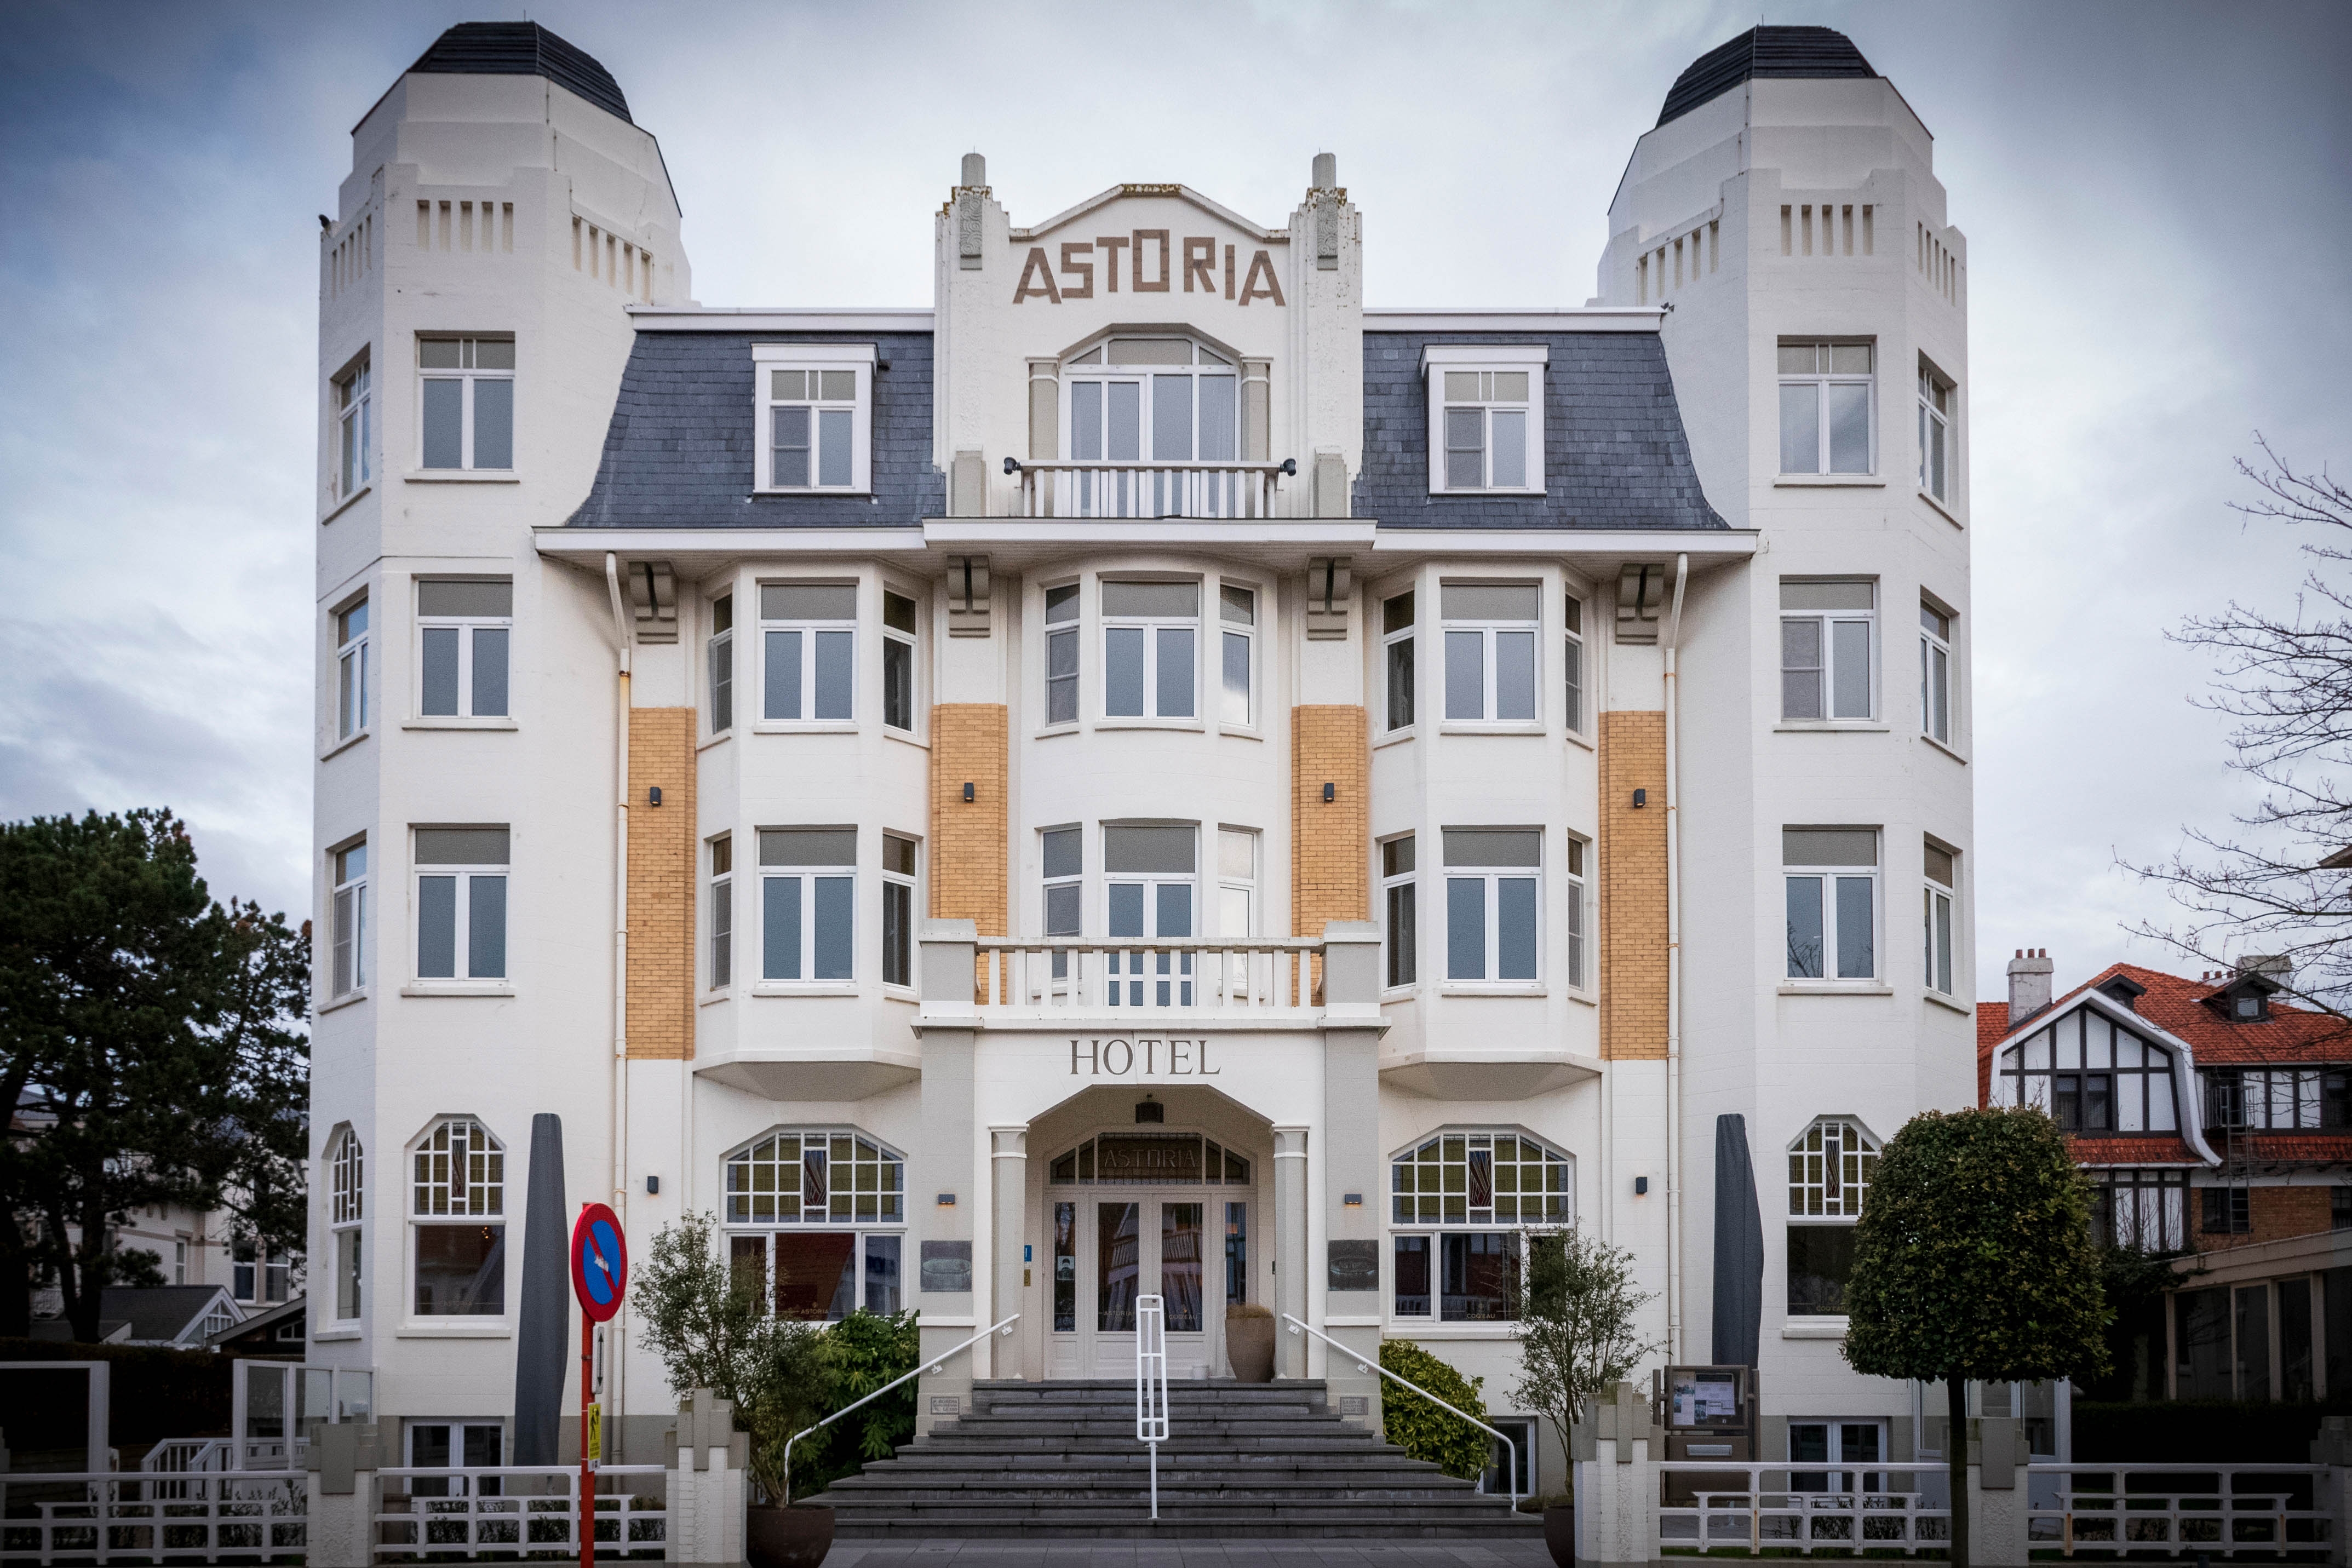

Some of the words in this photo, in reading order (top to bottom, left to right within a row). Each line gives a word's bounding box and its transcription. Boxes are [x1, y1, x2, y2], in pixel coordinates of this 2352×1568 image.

[1012, 228, 1286, 306] ASTORIA
[1069, 1039, 1221, 1075] HOTEL
[1104, 1149, 1196, 1168] ASTORIA
